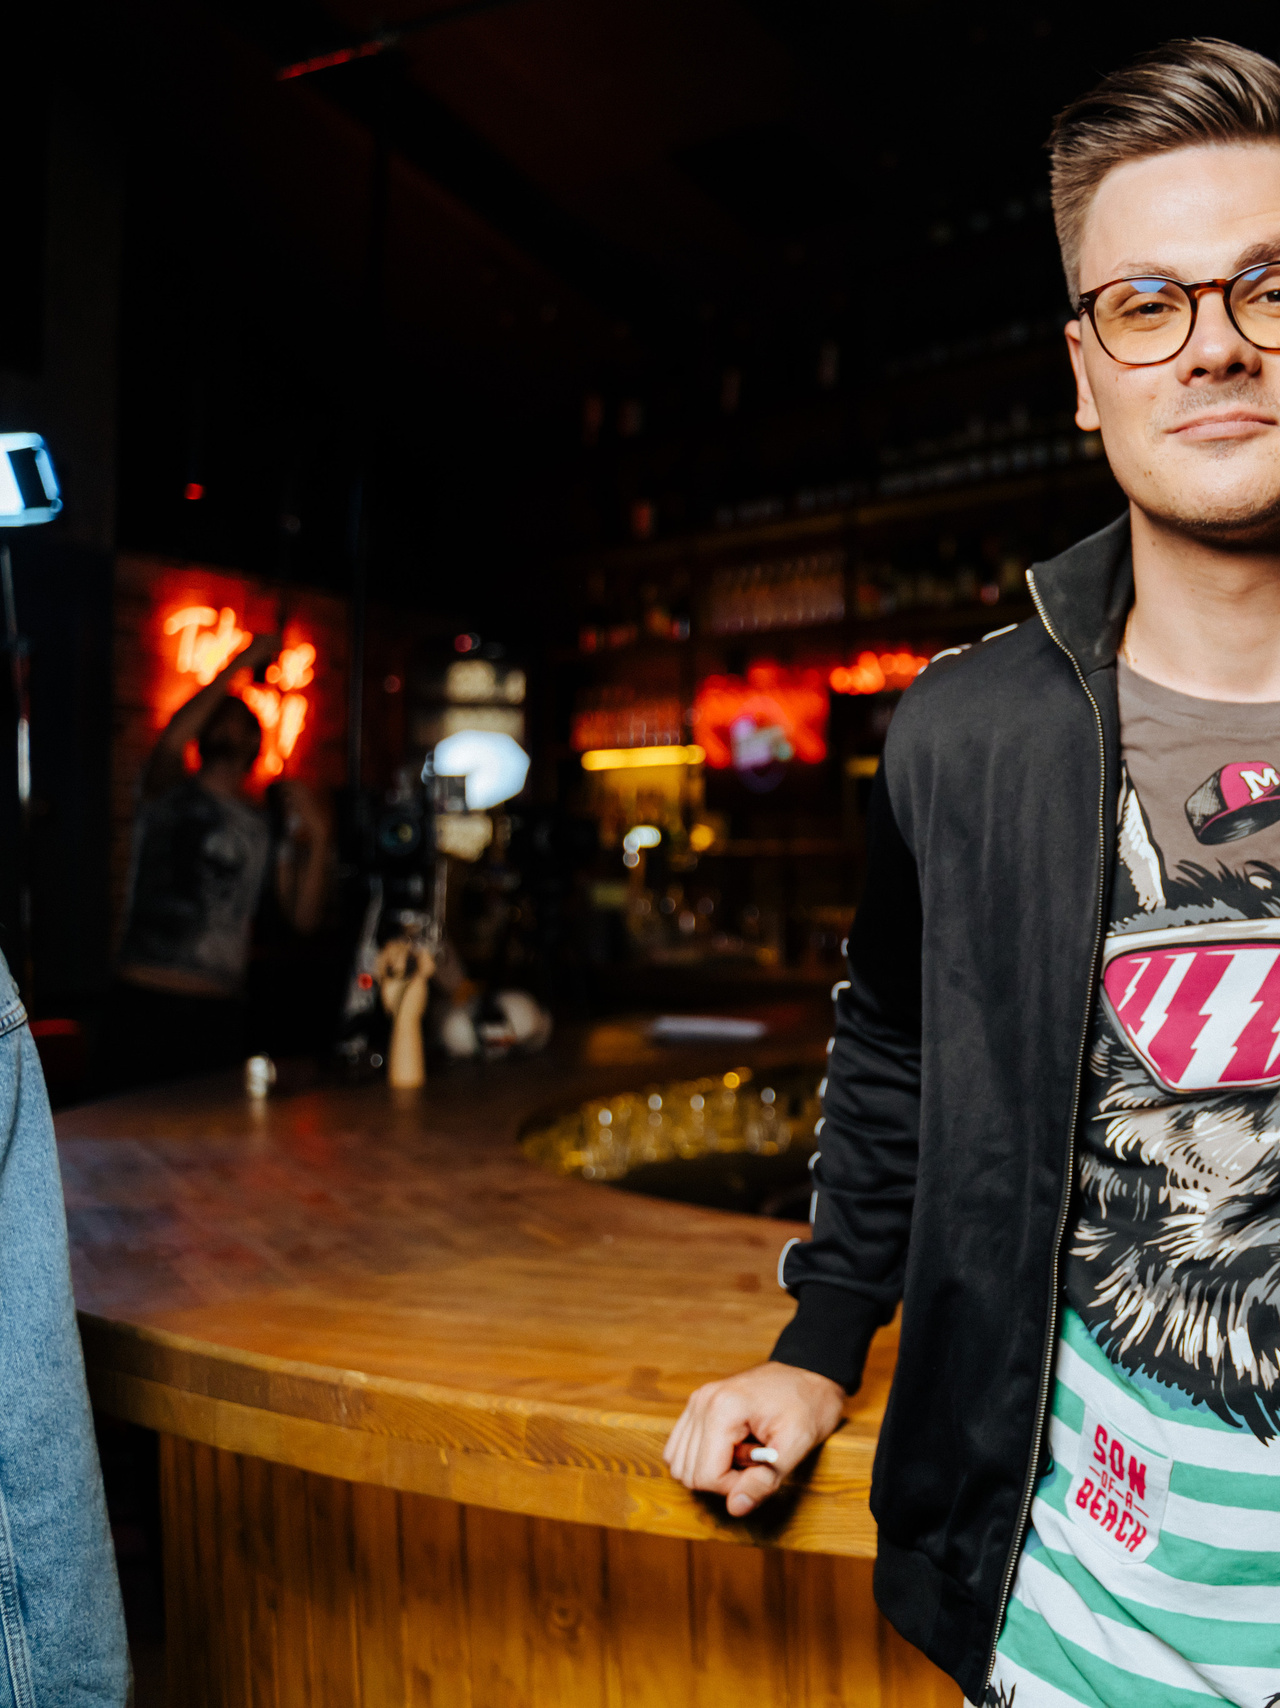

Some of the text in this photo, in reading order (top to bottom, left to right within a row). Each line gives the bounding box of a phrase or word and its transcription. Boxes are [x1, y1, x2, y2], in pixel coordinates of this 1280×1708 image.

[1239, 768, 1280, 800] M
[1093, 1424, 1146, 1500] SON
[1100, 1470, 1133, 1509] OF A
[1075, 1477, 1147, 1552] BEACH
